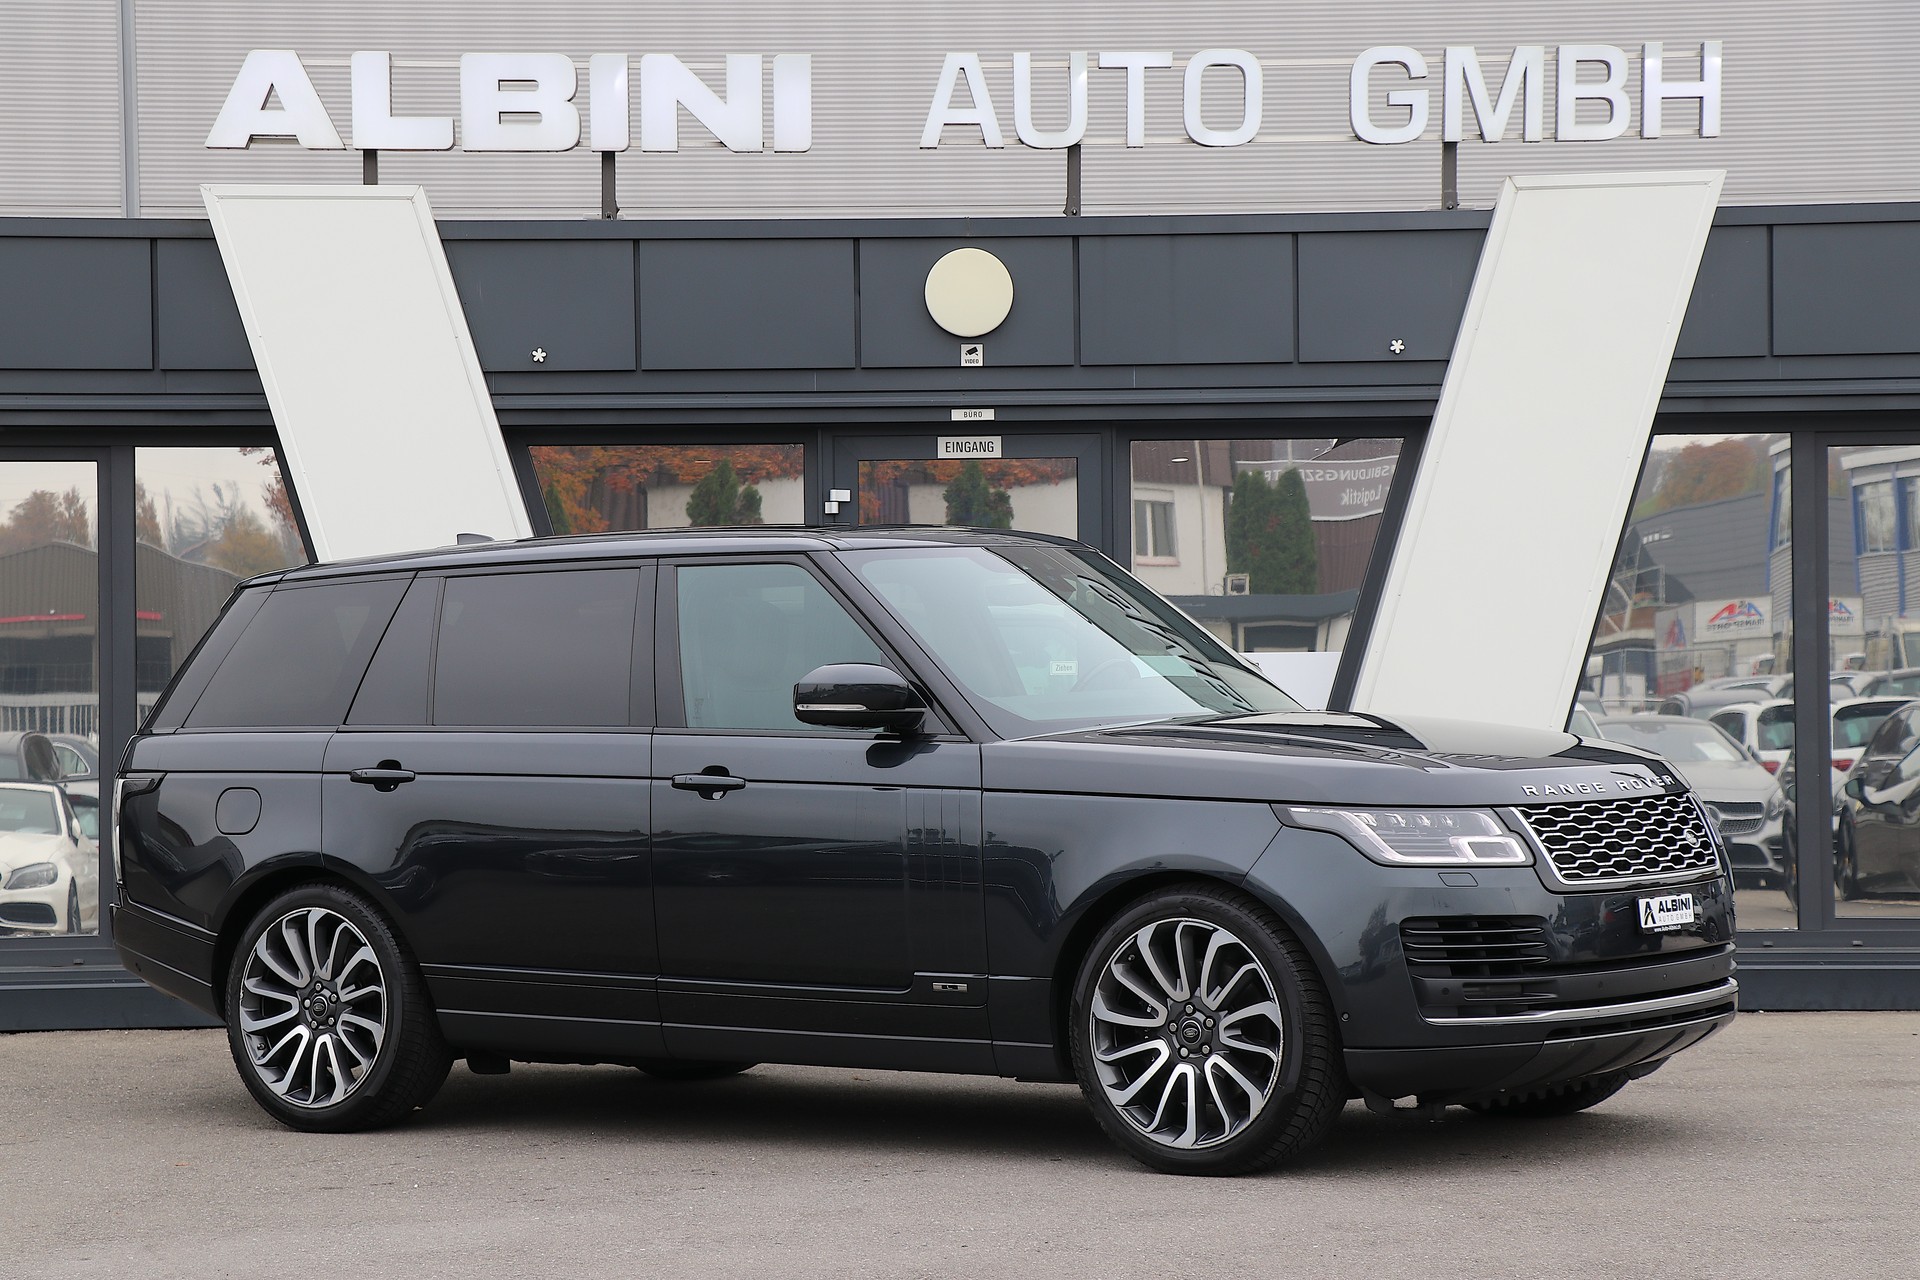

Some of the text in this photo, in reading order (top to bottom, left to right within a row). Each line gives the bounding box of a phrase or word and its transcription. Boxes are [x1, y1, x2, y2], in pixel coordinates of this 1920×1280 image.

[204, 40, 1723, 153] ALBINI AUTO GMBH
[963, 409, 983, 419] BÜRO
[944, 441, 995, 454] EINGANG
[1521, 774, 1676, 797] RANGE ROVER
[1658, 897, 1691, 914] ALBINI
[1659, 914, 1675, 922] AUTO
